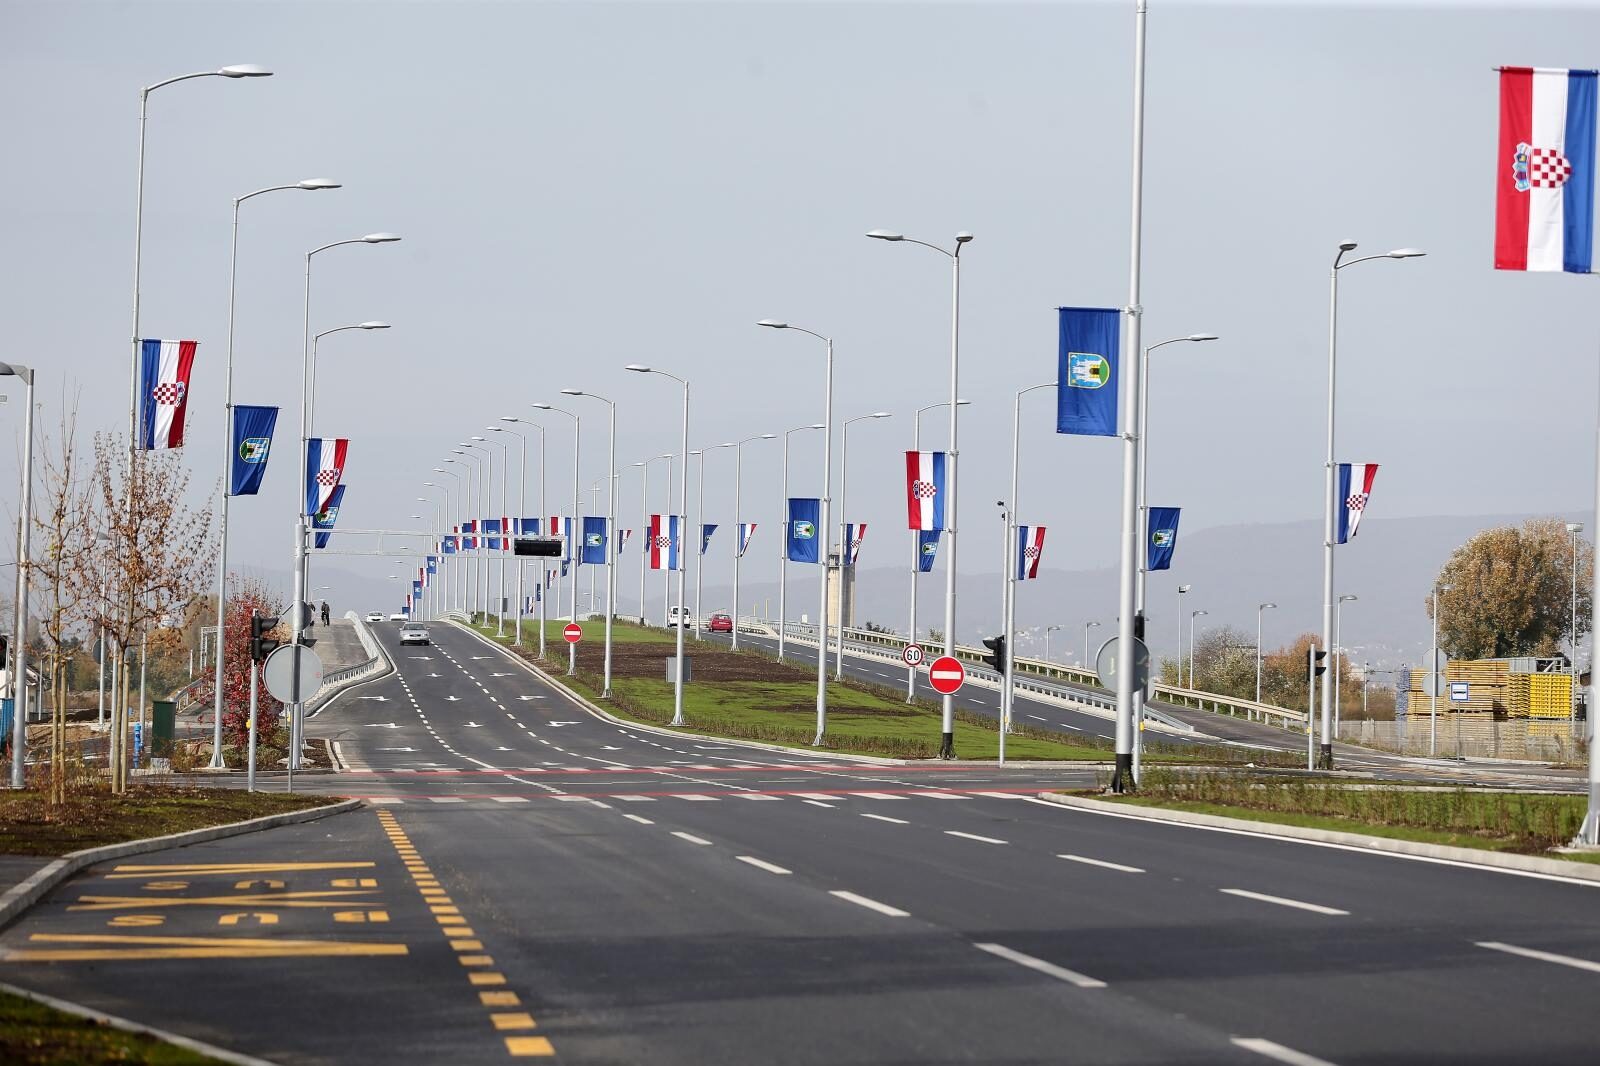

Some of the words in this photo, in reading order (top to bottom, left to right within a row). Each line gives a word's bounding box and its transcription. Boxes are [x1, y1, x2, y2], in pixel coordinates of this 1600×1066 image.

[907, 650, 920, 661] 60
[141, 878, 378, 890] BUS
[107, 911, 390, 926] BUS
